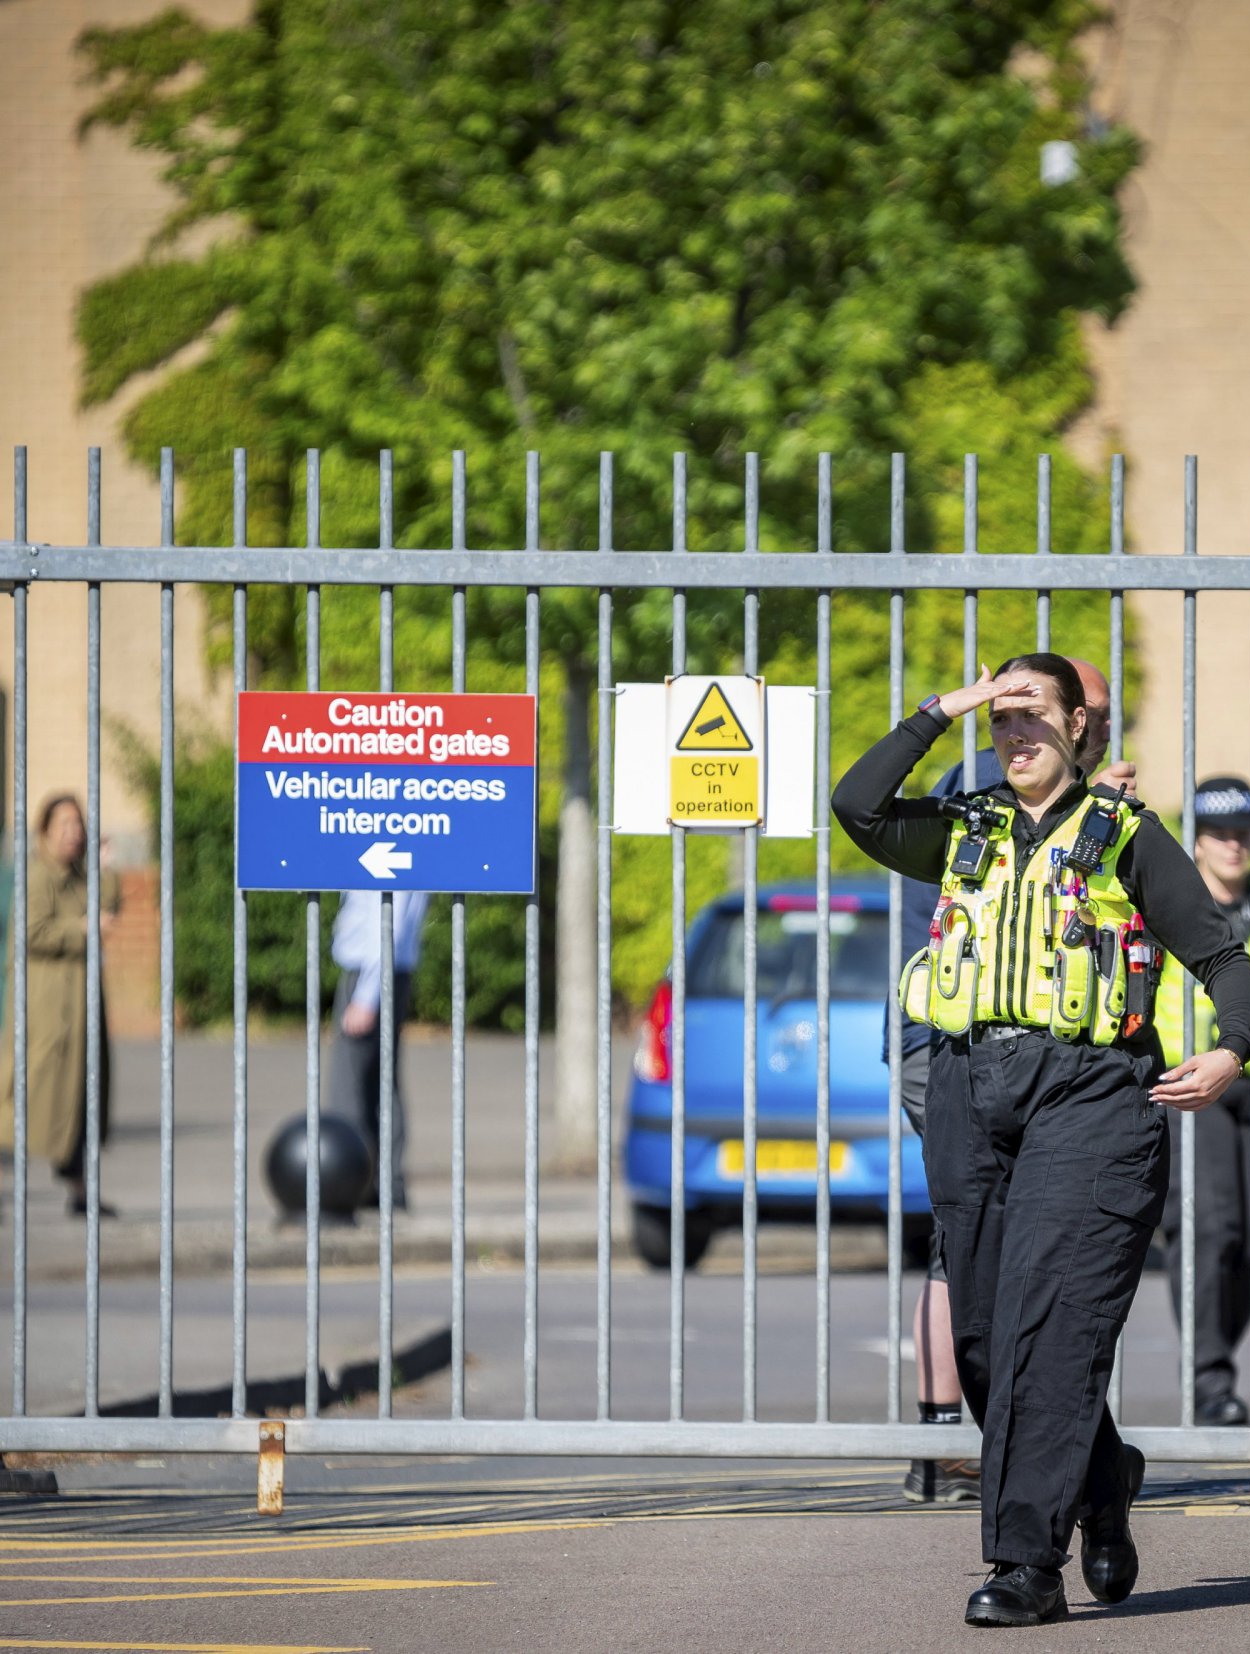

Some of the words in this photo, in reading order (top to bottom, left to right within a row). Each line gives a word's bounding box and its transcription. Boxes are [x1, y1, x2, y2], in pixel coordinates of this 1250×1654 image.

[328, 698, 444, 727] Caution
[262, 725, 425, 756] Automated
[429, 729, 511, 763] gates
[691, 762, 739, 777] CCTV
[265, 770, 401, 799] Vehicular
[403, 777, 506, 801] access
[707, 781, 722, 794] in
[319, 806, 451, 835] intercom
[676, 799, 753, 815] operation
